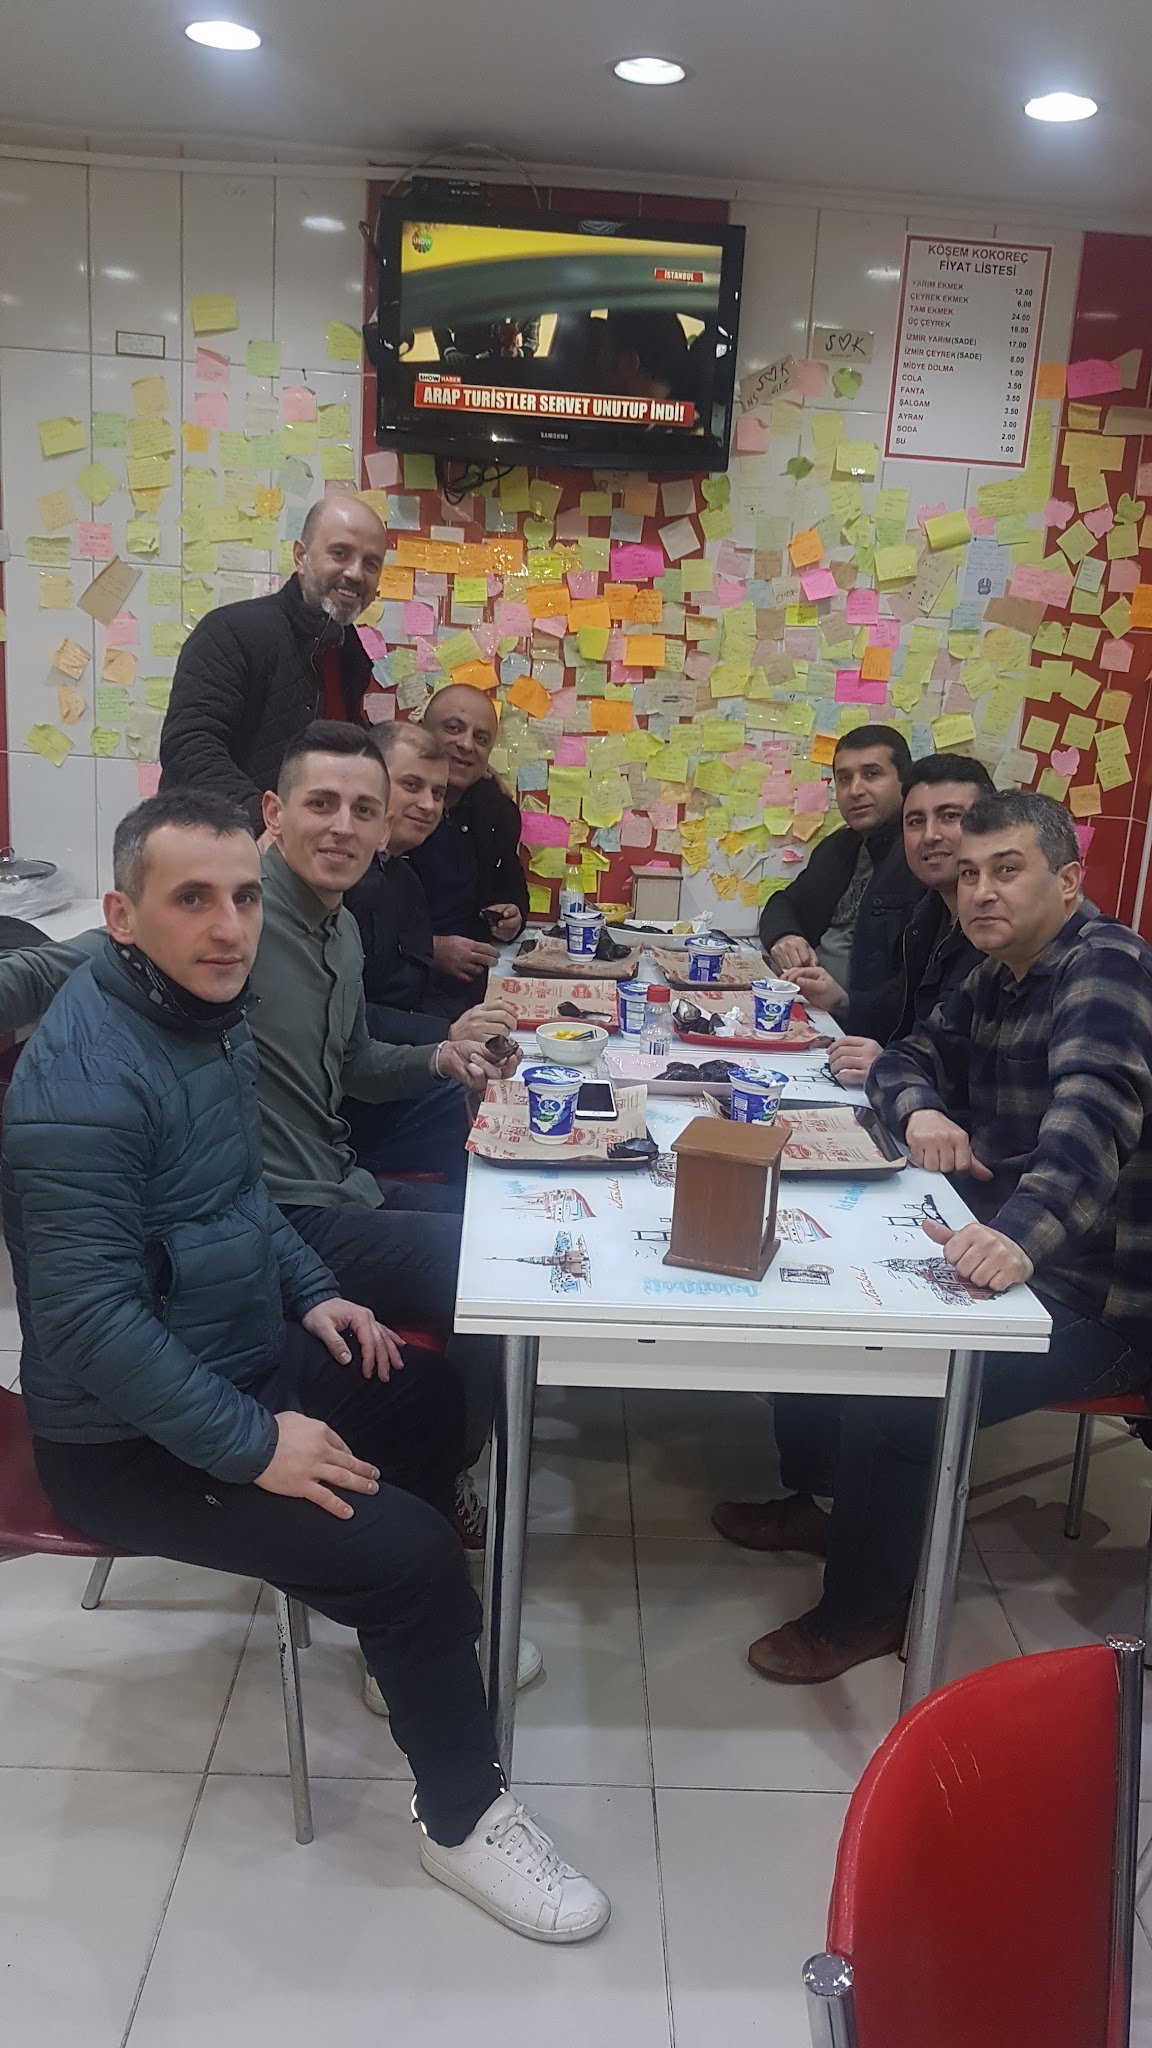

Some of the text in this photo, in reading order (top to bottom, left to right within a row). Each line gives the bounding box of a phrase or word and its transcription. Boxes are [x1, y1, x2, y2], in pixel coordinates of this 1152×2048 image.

[972, 248, 1029, 264] KOKOREÇ
[940, 258, 1017, 277] FİYAT LİSTESİ
[937, 282, 964, 290] EKMEK
[1015, 288, 1033, 296] 12.00
[942, 294, 969, 303] EKMEK
[910, 305, 953, 315] TAM EKMEK
[1011, 312, 1031, 321] 24.00
[920, 319, 951, 328] ÇEYREK
[902, 361, 954, 372] MİDYE DOLMA
[1010, 369, 1024, 377] 1.00
[419, 374, 440, 382] SHOW
[901, 374, 922, 382] COLA
[900, 386, 925, 395] FANTA
[423, 386, 685, 423] ARAP TURİSTLER SERVET UNUTUP İNDİ!
[899, 398, 930, 407] ŞALGAM
[898, 412, 924, 421] AYRAN
[897, 425, 918, 433] SODA
[540, 431, 569, 440] SAMSUNG
[1001, 433, 1016, 441] 2.00
[895, 437, 906, 445] SU
[1000, 445, 1014, 453] 1.00
